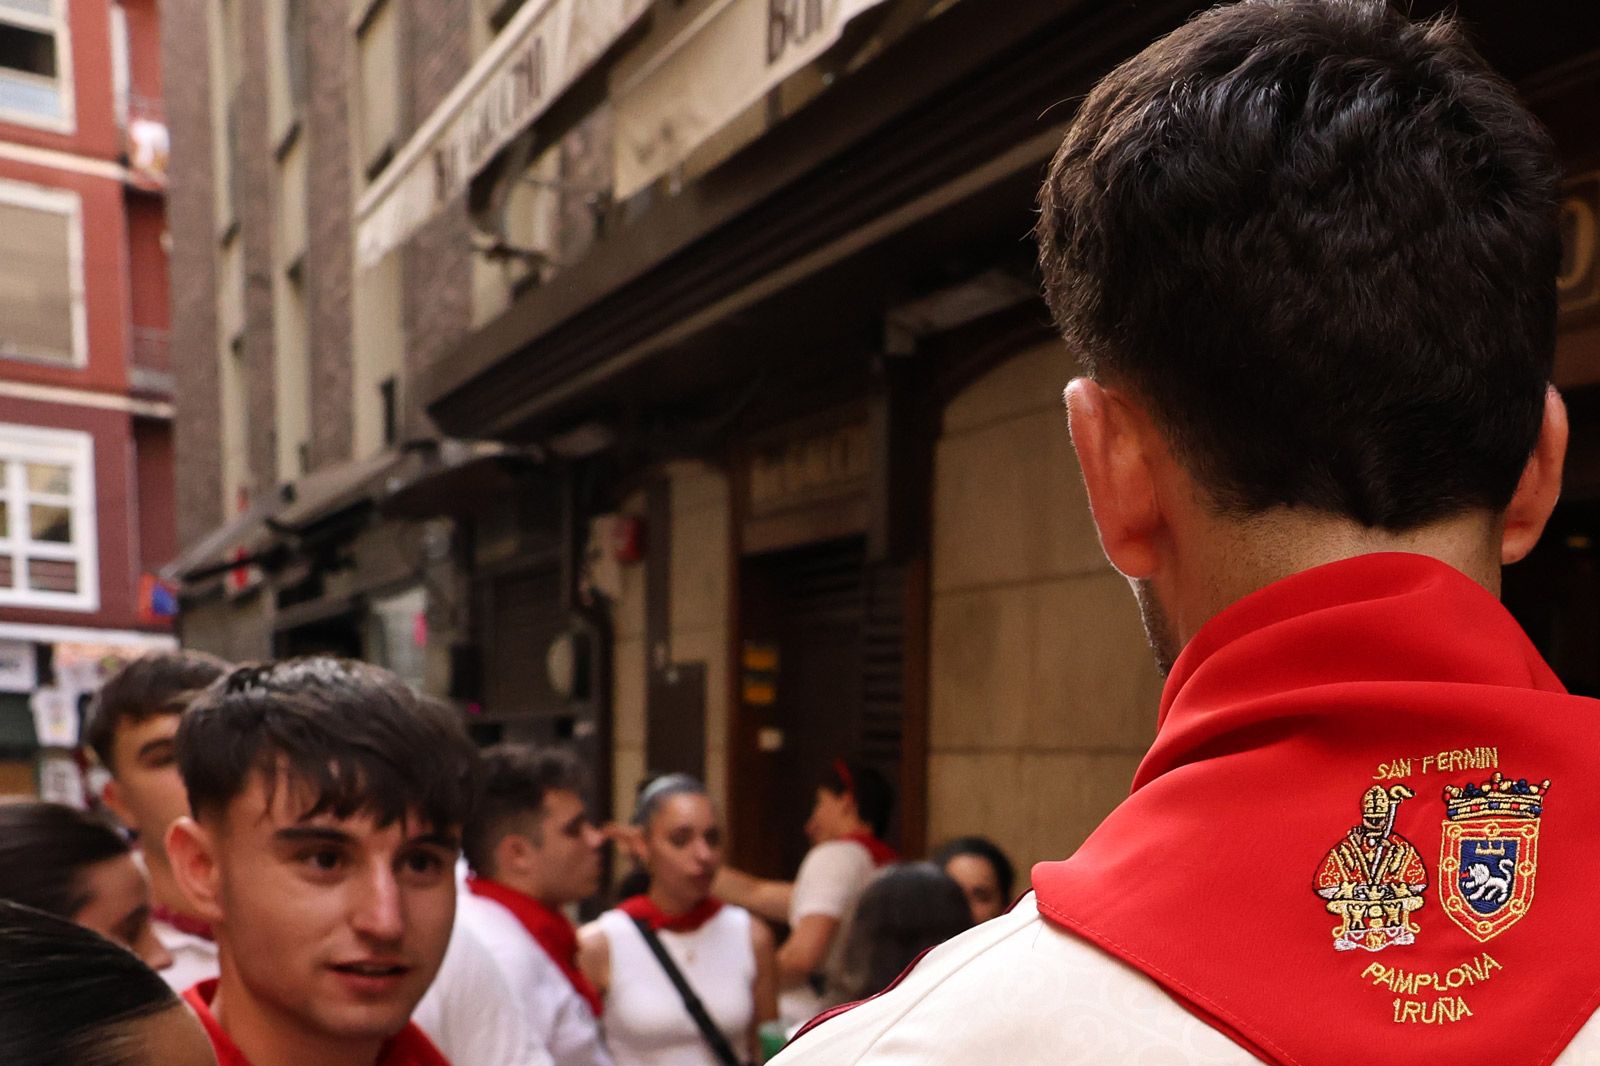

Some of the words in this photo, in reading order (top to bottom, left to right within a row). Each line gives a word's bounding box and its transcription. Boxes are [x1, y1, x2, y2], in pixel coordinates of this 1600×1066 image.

[1372, 757, 1412, 780] SAN
[1422, 747, 1499, 775] FERMIN
[1361, 952, 1503, 995] PAMPLONA
[1393, 996, 1473, 1025] IRUÑA
